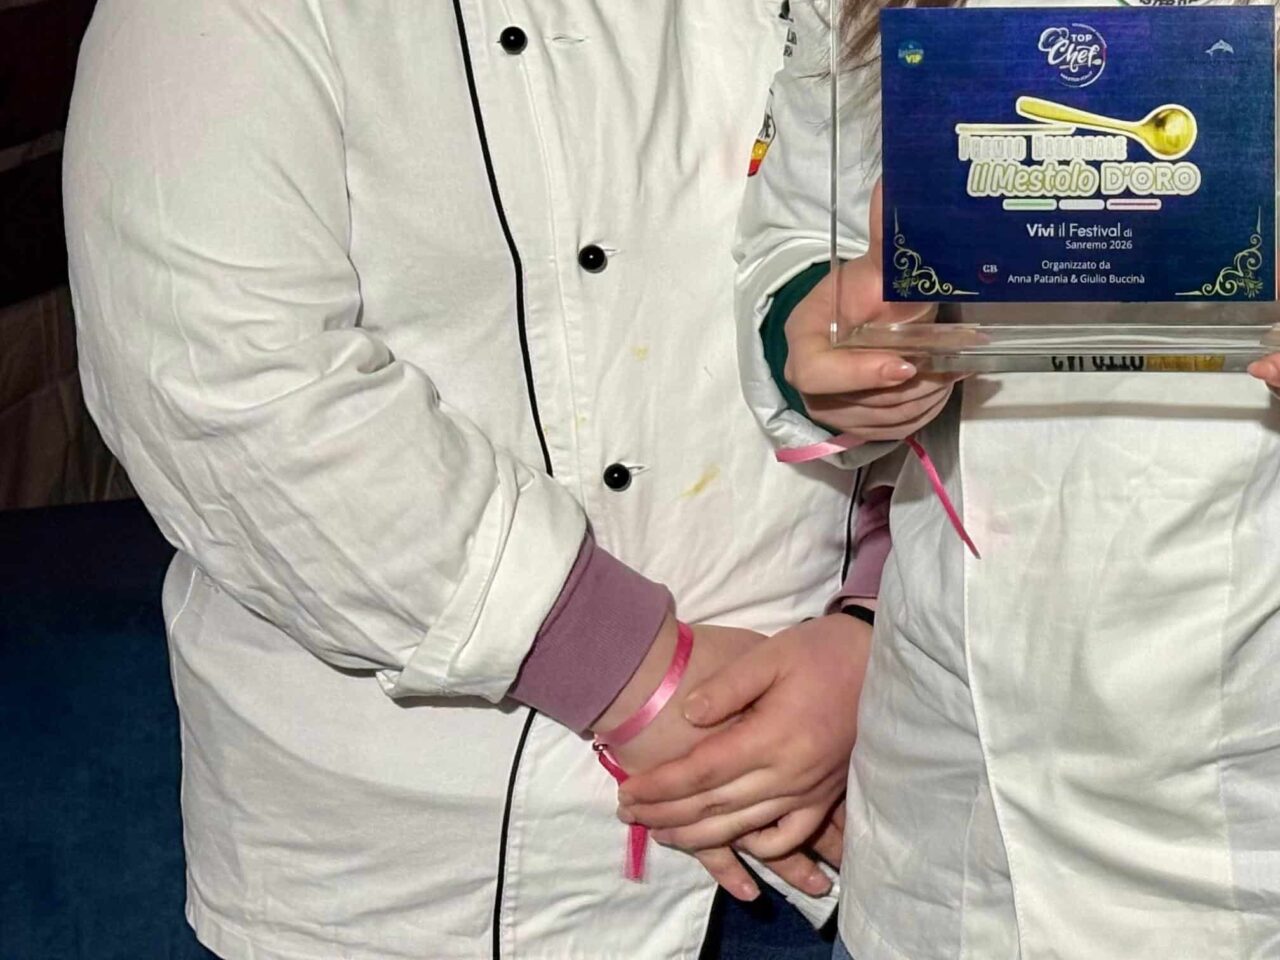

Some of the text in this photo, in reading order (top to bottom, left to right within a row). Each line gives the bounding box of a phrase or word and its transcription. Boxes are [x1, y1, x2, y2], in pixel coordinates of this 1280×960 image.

[1070, 33, 1093, 42] TOP
[1048, 40, 1102, 73] Chef
[993, 160, 1097, 196] Mestolo
[1102, 163, 1200, 195] D'ORO
[1026, 222, 1133, 238] Vivi il Festival di
[1065, 239, 1133, 250] Sanremo 2026
[1041, 259, 1111, 274] Organizzato da
[1007, 273, 1146, 284] Anna Patania & Giulio Buccinà
